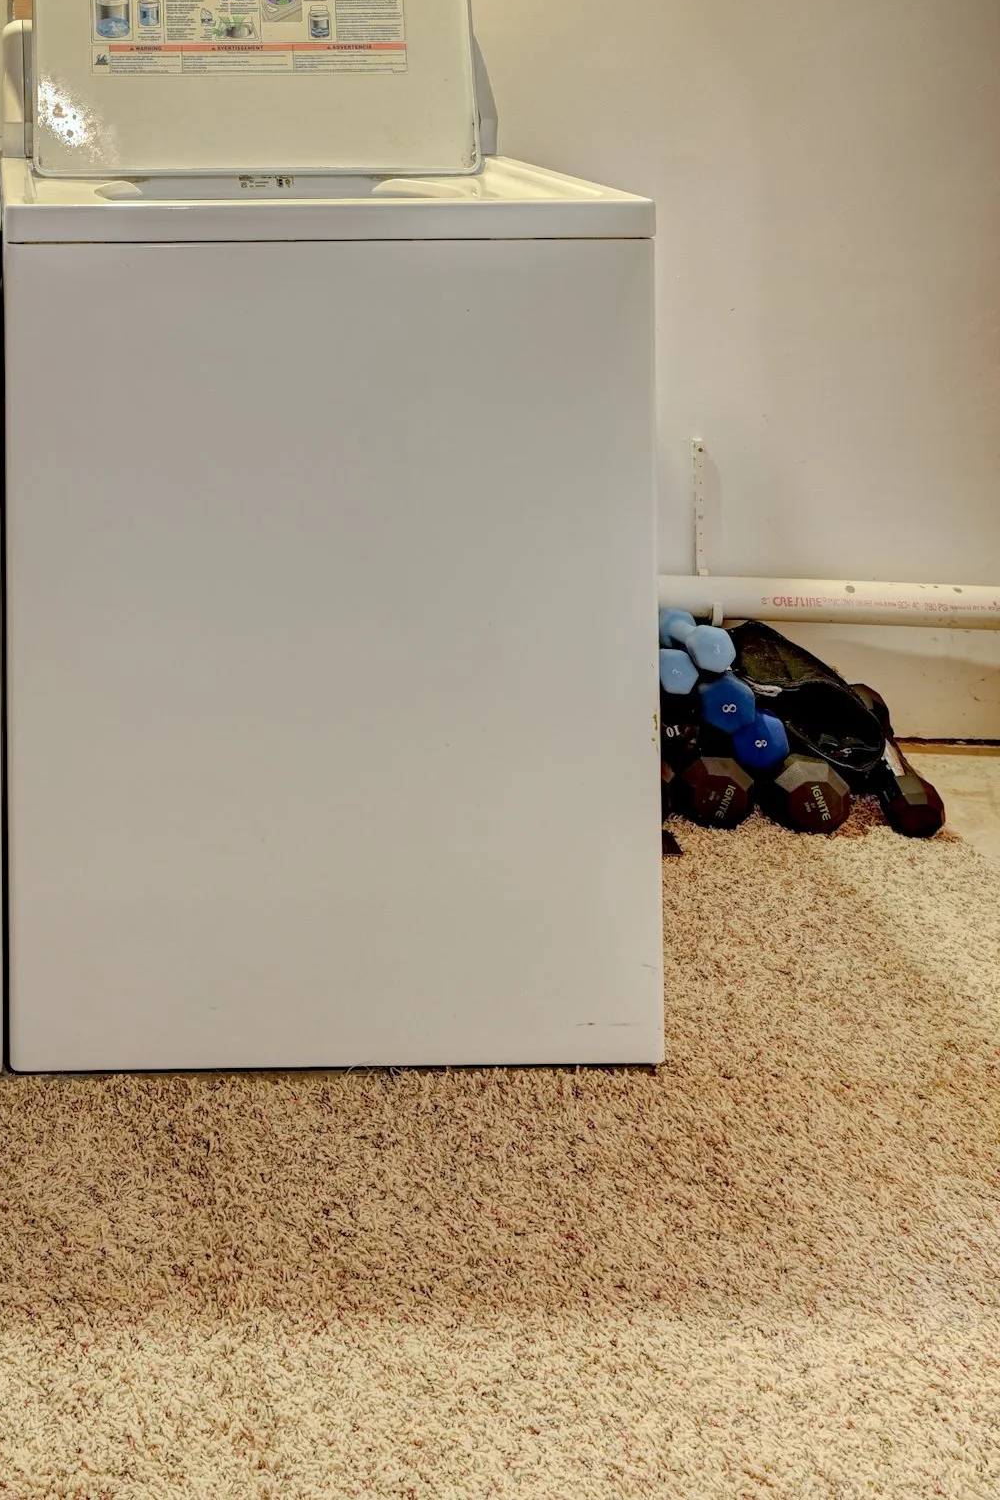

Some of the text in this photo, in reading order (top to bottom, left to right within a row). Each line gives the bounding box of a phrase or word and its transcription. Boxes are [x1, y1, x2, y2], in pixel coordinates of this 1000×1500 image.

[773, 596, 823, 607] CRESLINE
[713, 644, 721, 655] 3
[722, 703, 738, 713] 8
[666, 724, 682, 738] 10
[754, 739, 768, 748] 8
[715, 784, 737, 820] IGNITE
[811, 785, 832, 821] IGNITE
